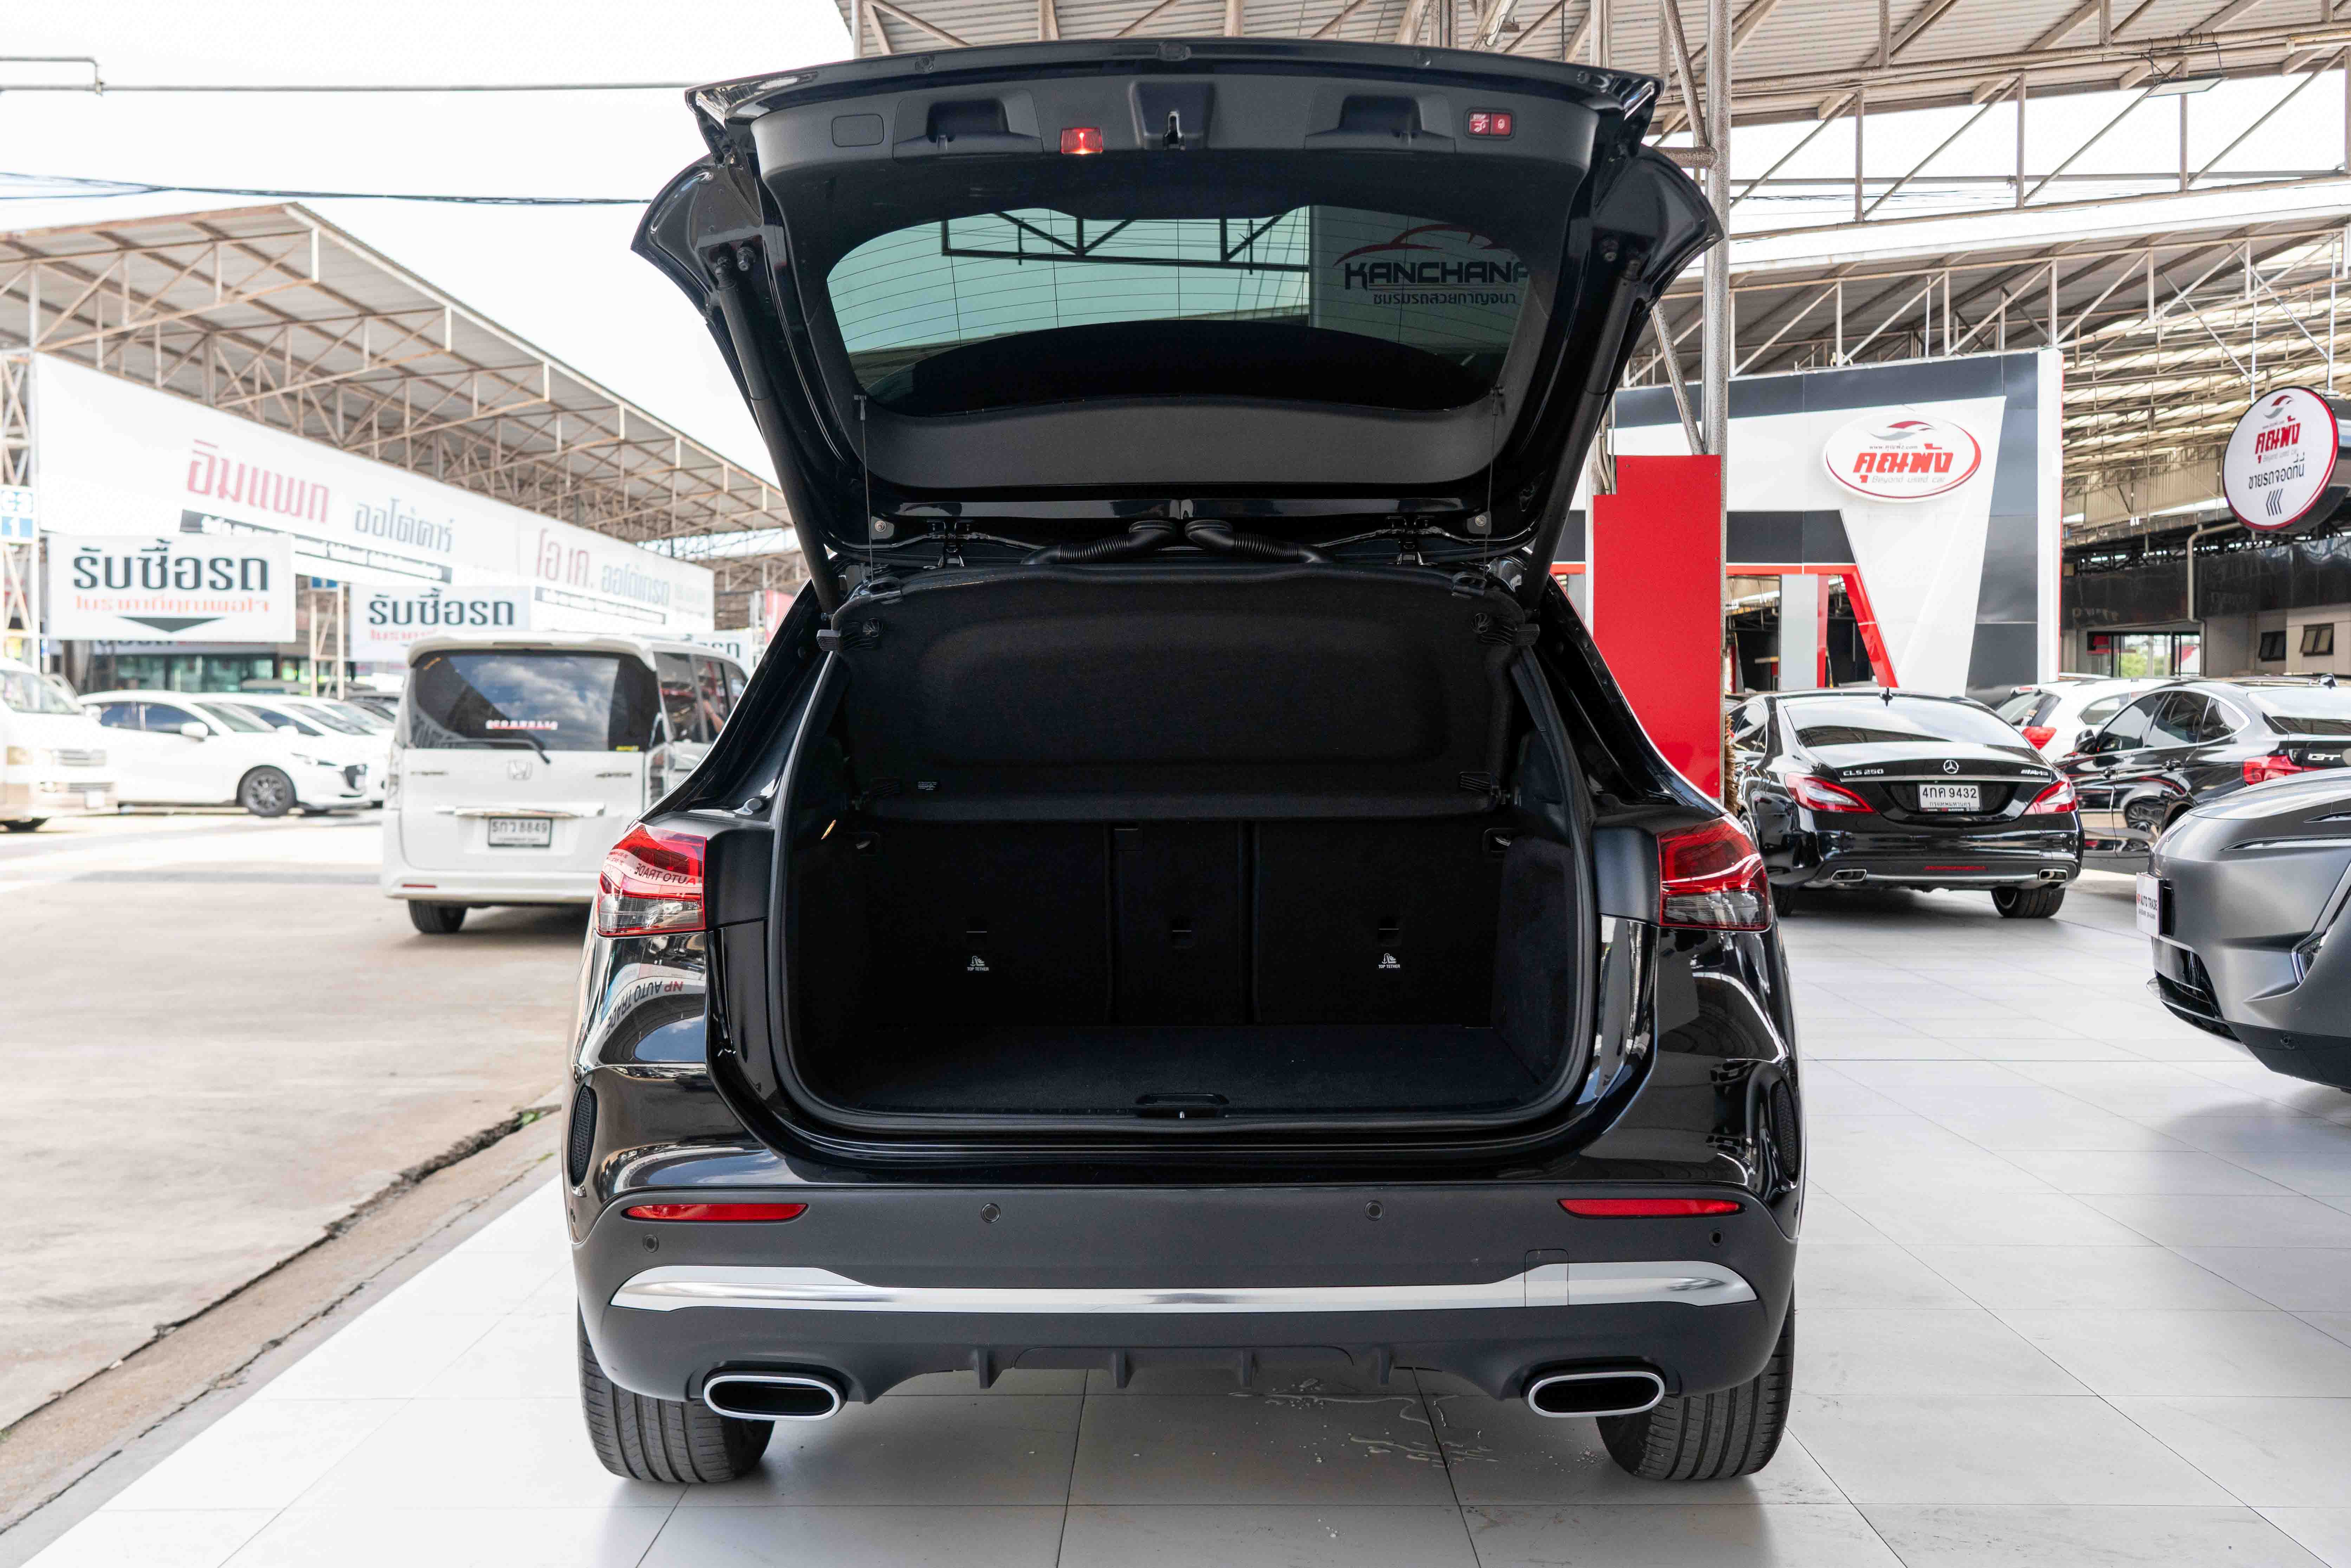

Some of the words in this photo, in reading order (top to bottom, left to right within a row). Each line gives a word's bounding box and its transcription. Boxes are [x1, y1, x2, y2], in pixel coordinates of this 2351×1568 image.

[73, 538, 269, 590] รับซื้อรถ
[369, 588, 514, 626] รับซื้อรถ
[1949, 788, 1977, 798] 9432
